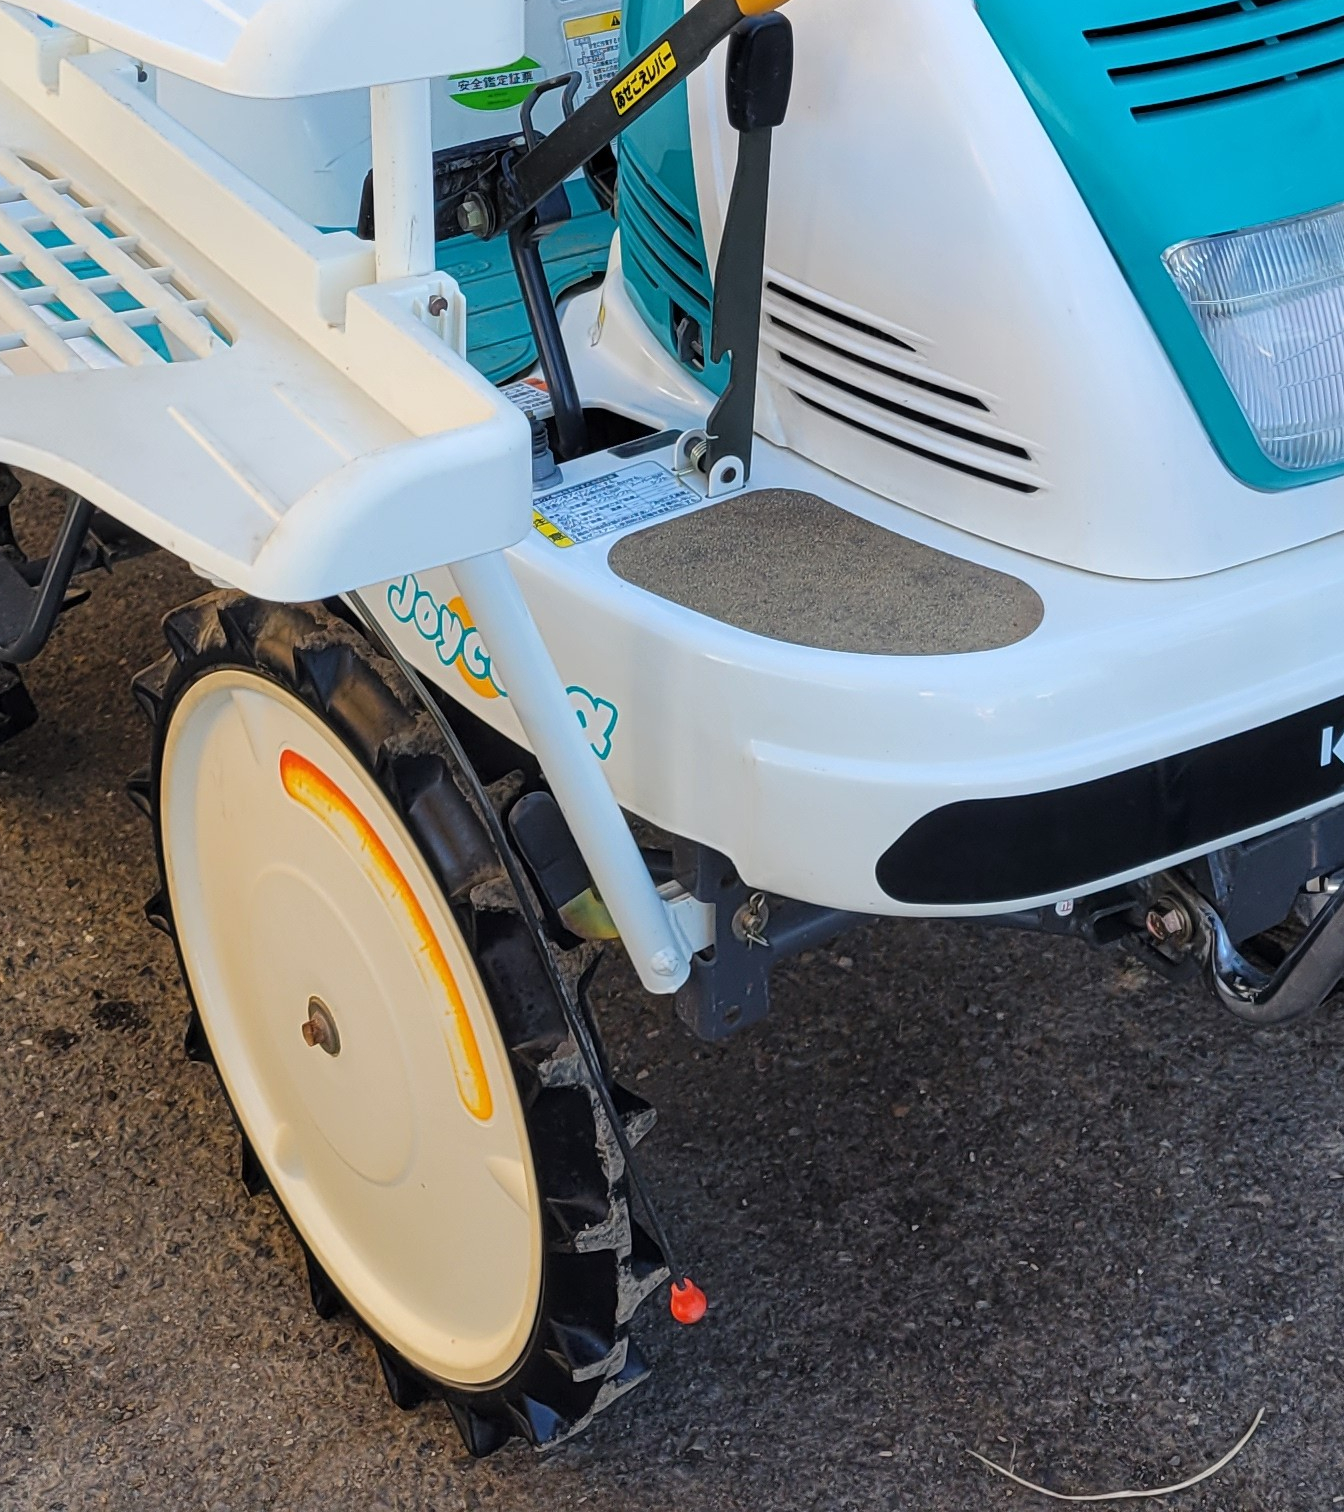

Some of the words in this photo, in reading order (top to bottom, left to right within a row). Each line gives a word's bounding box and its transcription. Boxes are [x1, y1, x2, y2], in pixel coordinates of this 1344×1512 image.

[457, 71, 534, 92] 安全鑑定証票
[615, 52, 672, 109] あぜごえレバー
